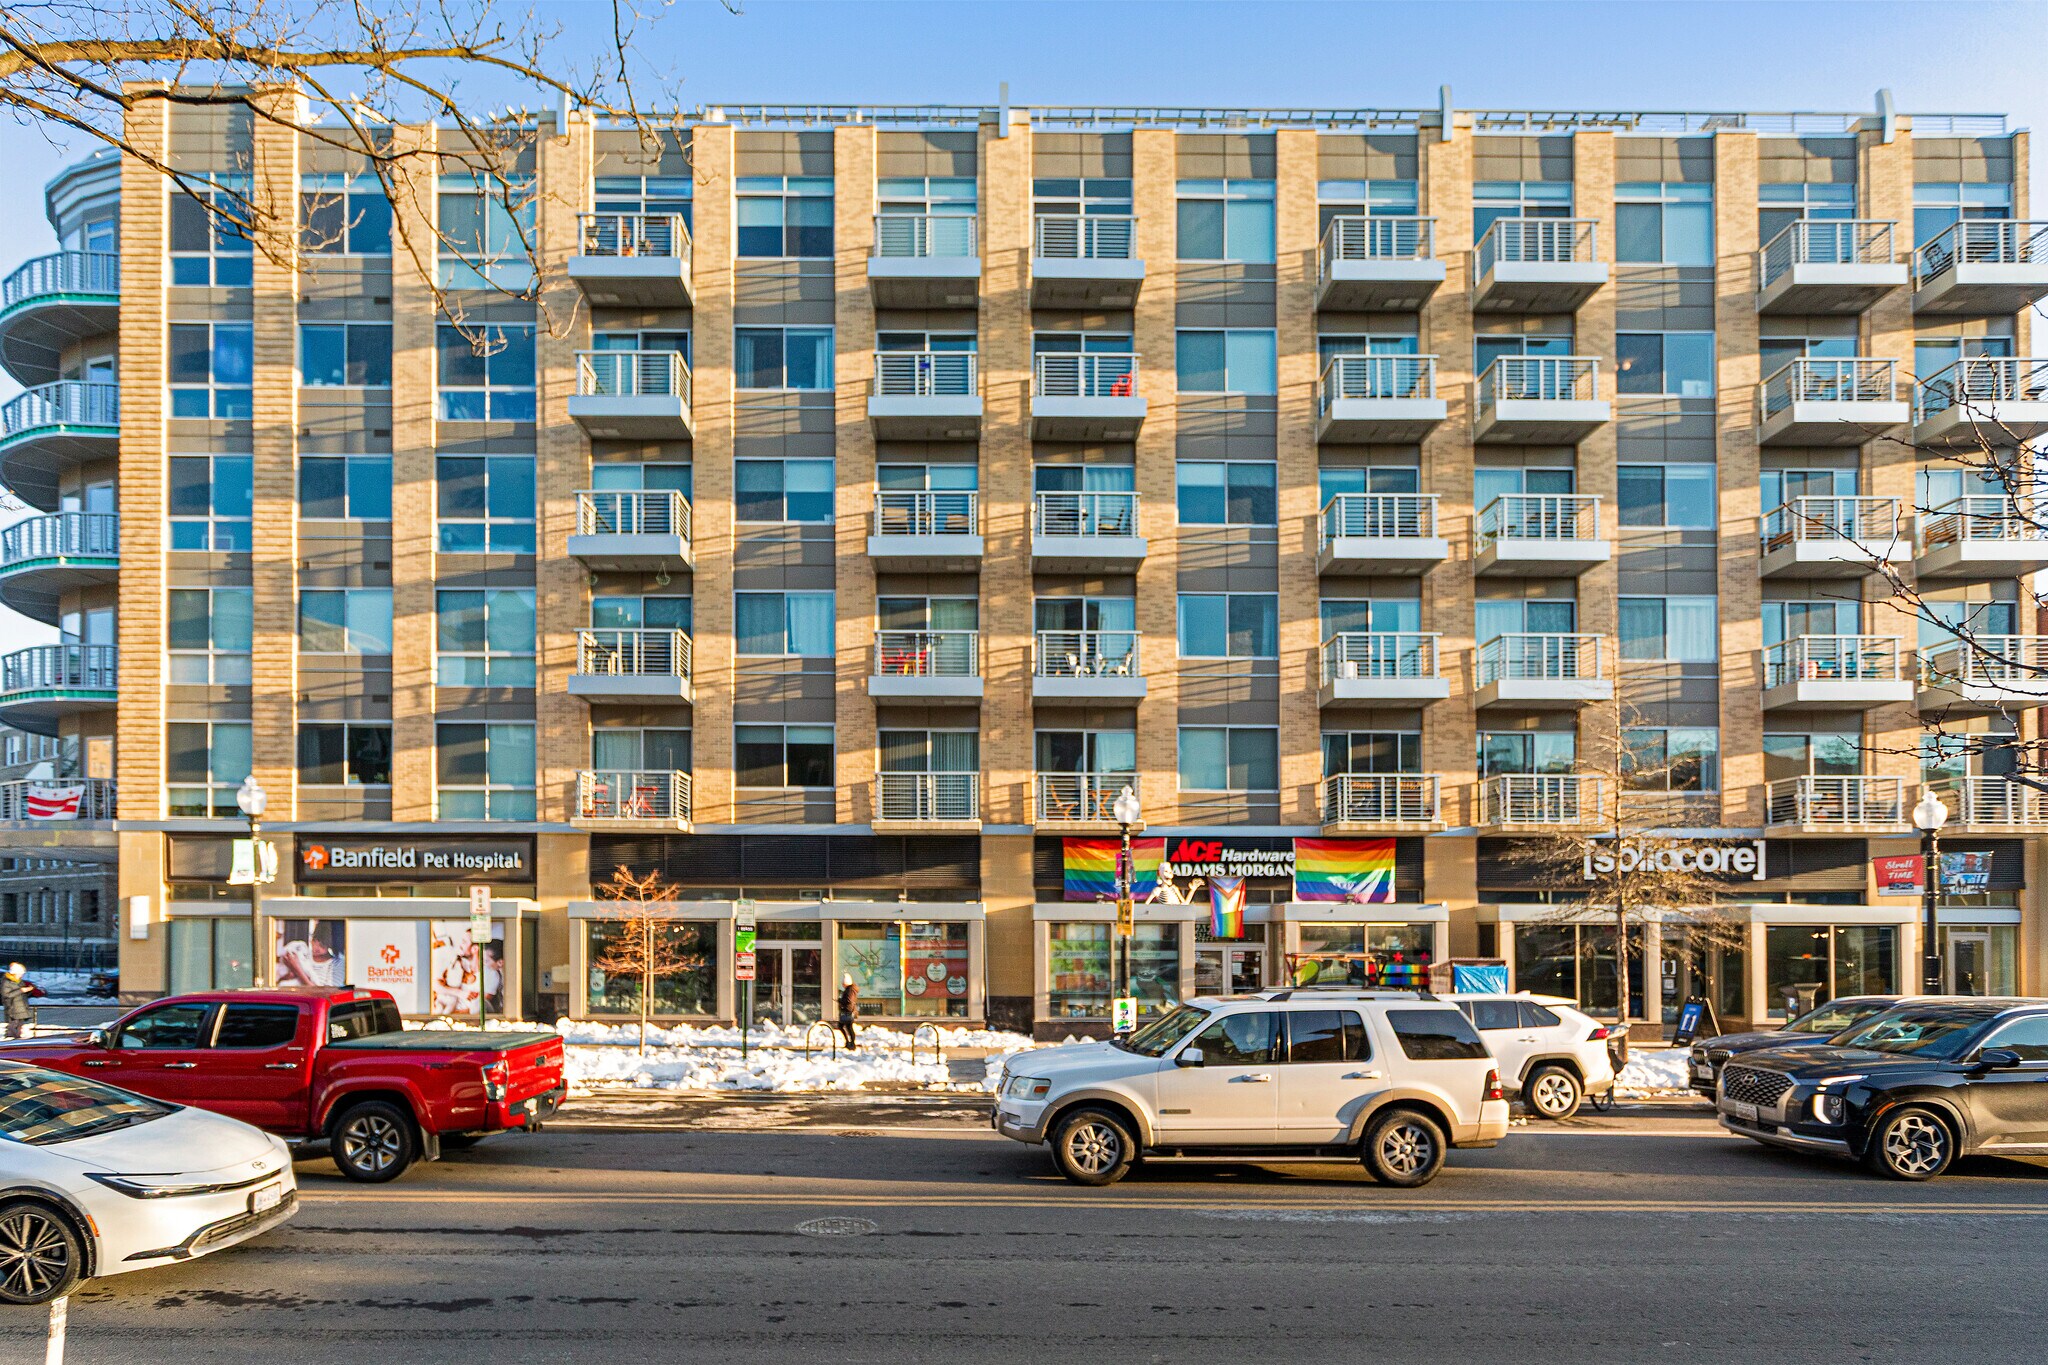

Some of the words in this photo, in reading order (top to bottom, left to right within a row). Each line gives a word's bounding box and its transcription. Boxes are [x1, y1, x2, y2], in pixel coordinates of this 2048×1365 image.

[1170, 838, 1223, 862] ACE
[1220, 849, 1296, 862] Hardware
[330, 847, 417, 868] Banfield
[423, 852, 450, 869] Pet
[453, 852, 519, 872] Hospital
[1885, 859, 1914, 870] Stroll
[1172, 863, 1226, 877] ADAMS
[1228, 863, 1295, 877] MORGAN
[1888, 871, 1914, 880] TIME
[367, 966, 413, 977] Banfield
